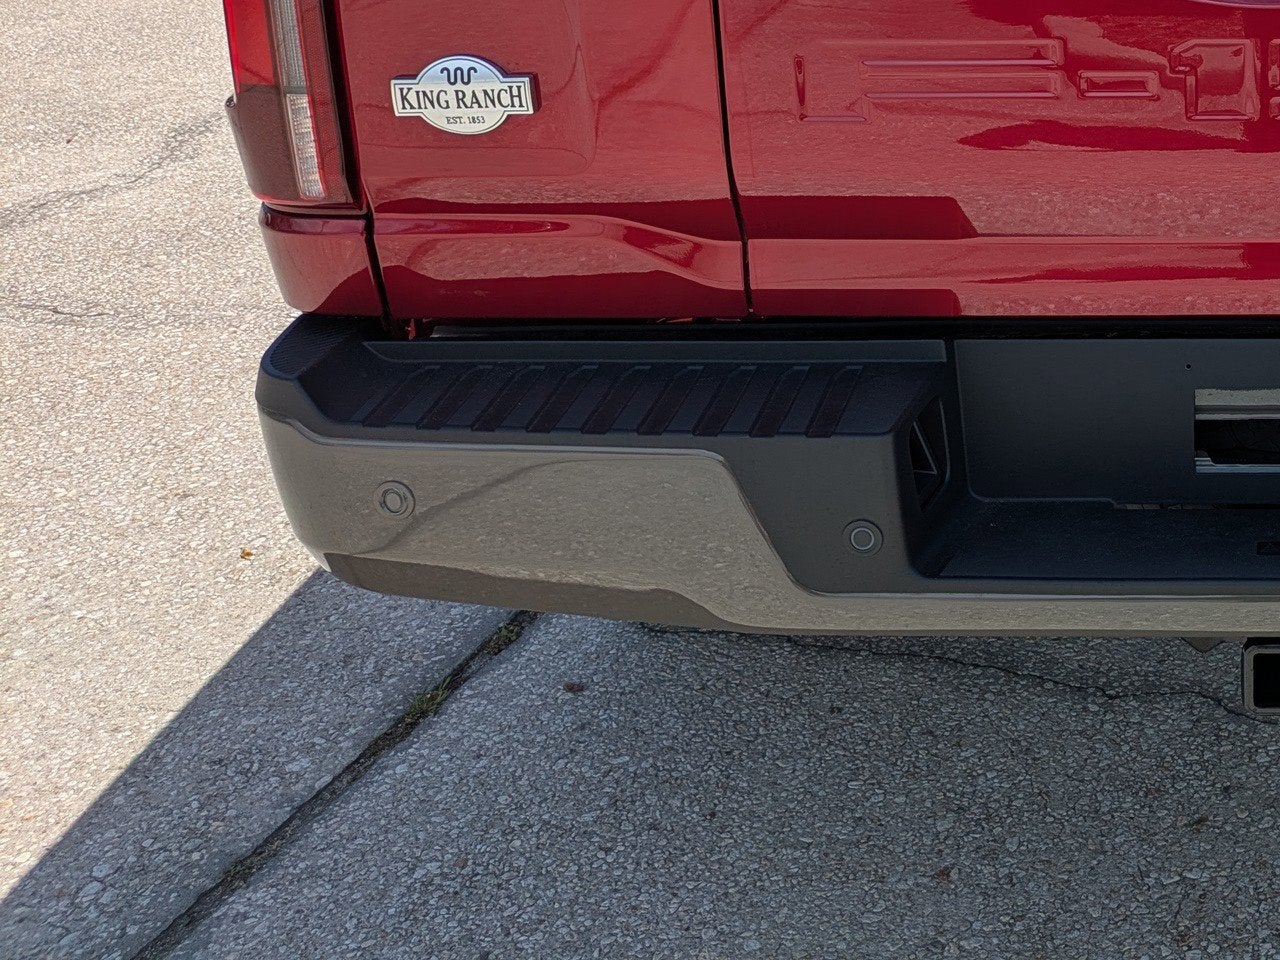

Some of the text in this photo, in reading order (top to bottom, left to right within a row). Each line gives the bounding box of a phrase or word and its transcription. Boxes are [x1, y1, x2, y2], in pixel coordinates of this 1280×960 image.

[398, 85, 525, 110] KING RANCH
[445, 115, 486, 125] EST. 1853
